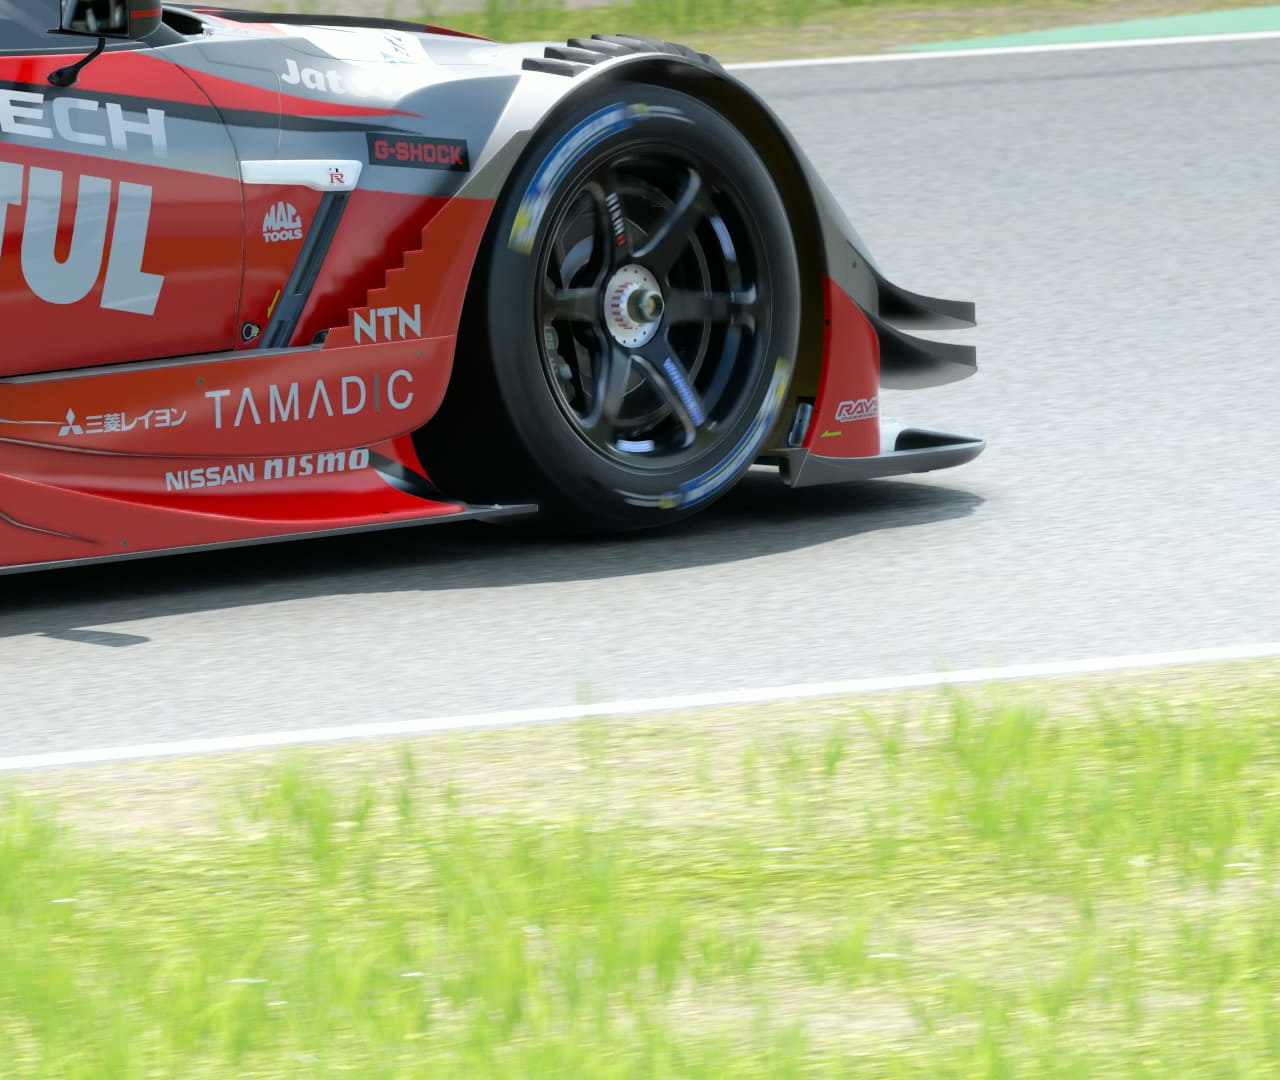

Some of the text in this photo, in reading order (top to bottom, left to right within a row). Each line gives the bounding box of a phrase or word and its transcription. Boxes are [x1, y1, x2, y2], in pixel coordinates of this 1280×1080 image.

[374, 140, 464, 165] G-SHOCK
[262, 201, 302, 233] MAC
[263, 229, 303, 243] TOOLS
[353, 304, 422, 344] NTN
[205, 369, 413, 429] TAMADIC
[85, 408, 188, 435] 三菱レイヨン
[166, 448, 370, 492] NISSAN nismo
